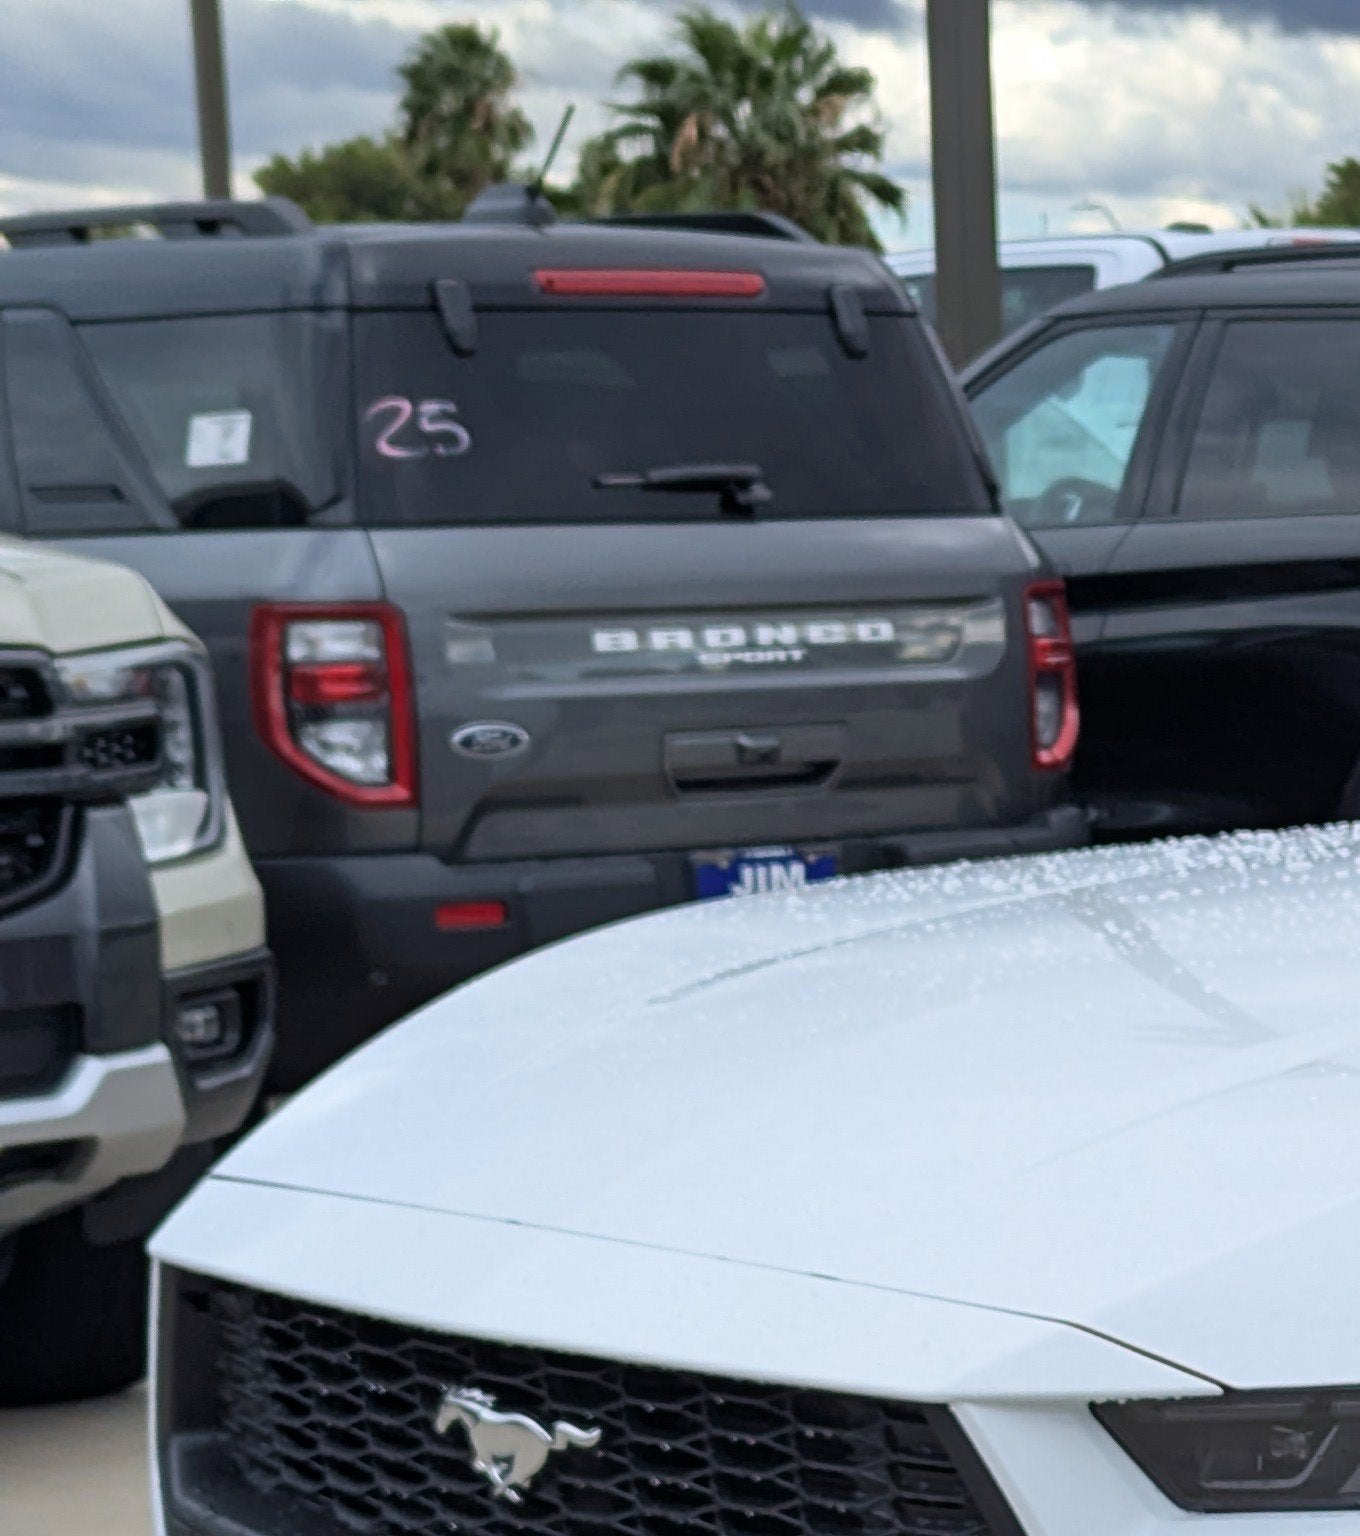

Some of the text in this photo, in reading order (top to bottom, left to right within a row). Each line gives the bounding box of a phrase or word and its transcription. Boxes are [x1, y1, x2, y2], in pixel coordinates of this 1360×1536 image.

[363, 397, 471, 458] 25
[593, 618, 895, 652] BRONCO
[697, 648, 806, 665] SPORT
[728, 859, 806, 896] JIM
